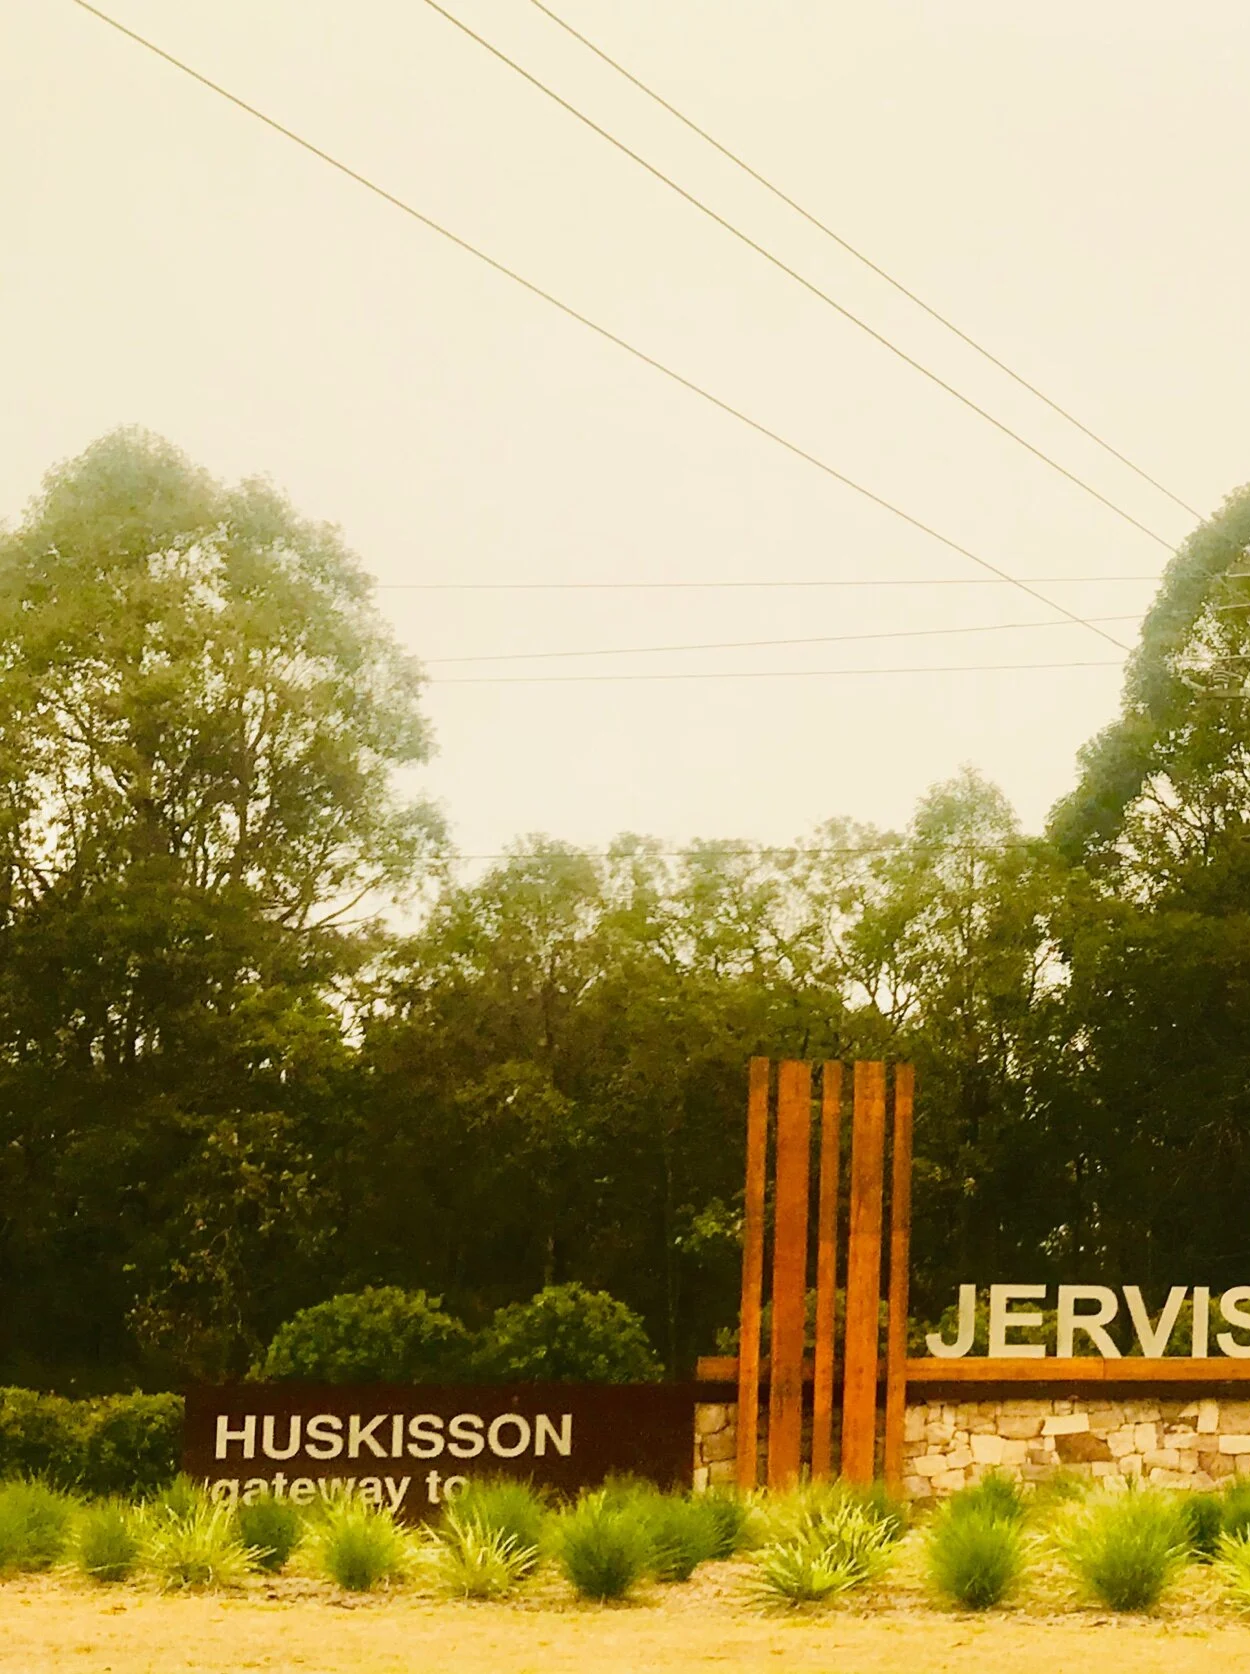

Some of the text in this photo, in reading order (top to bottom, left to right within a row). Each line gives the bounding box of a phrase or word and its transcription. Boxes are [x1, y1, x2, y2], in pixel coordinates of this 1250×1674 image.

[215, 1413, 573, 1459] HUSKISSON
[210, 1470, 470, 1513] gateway to
